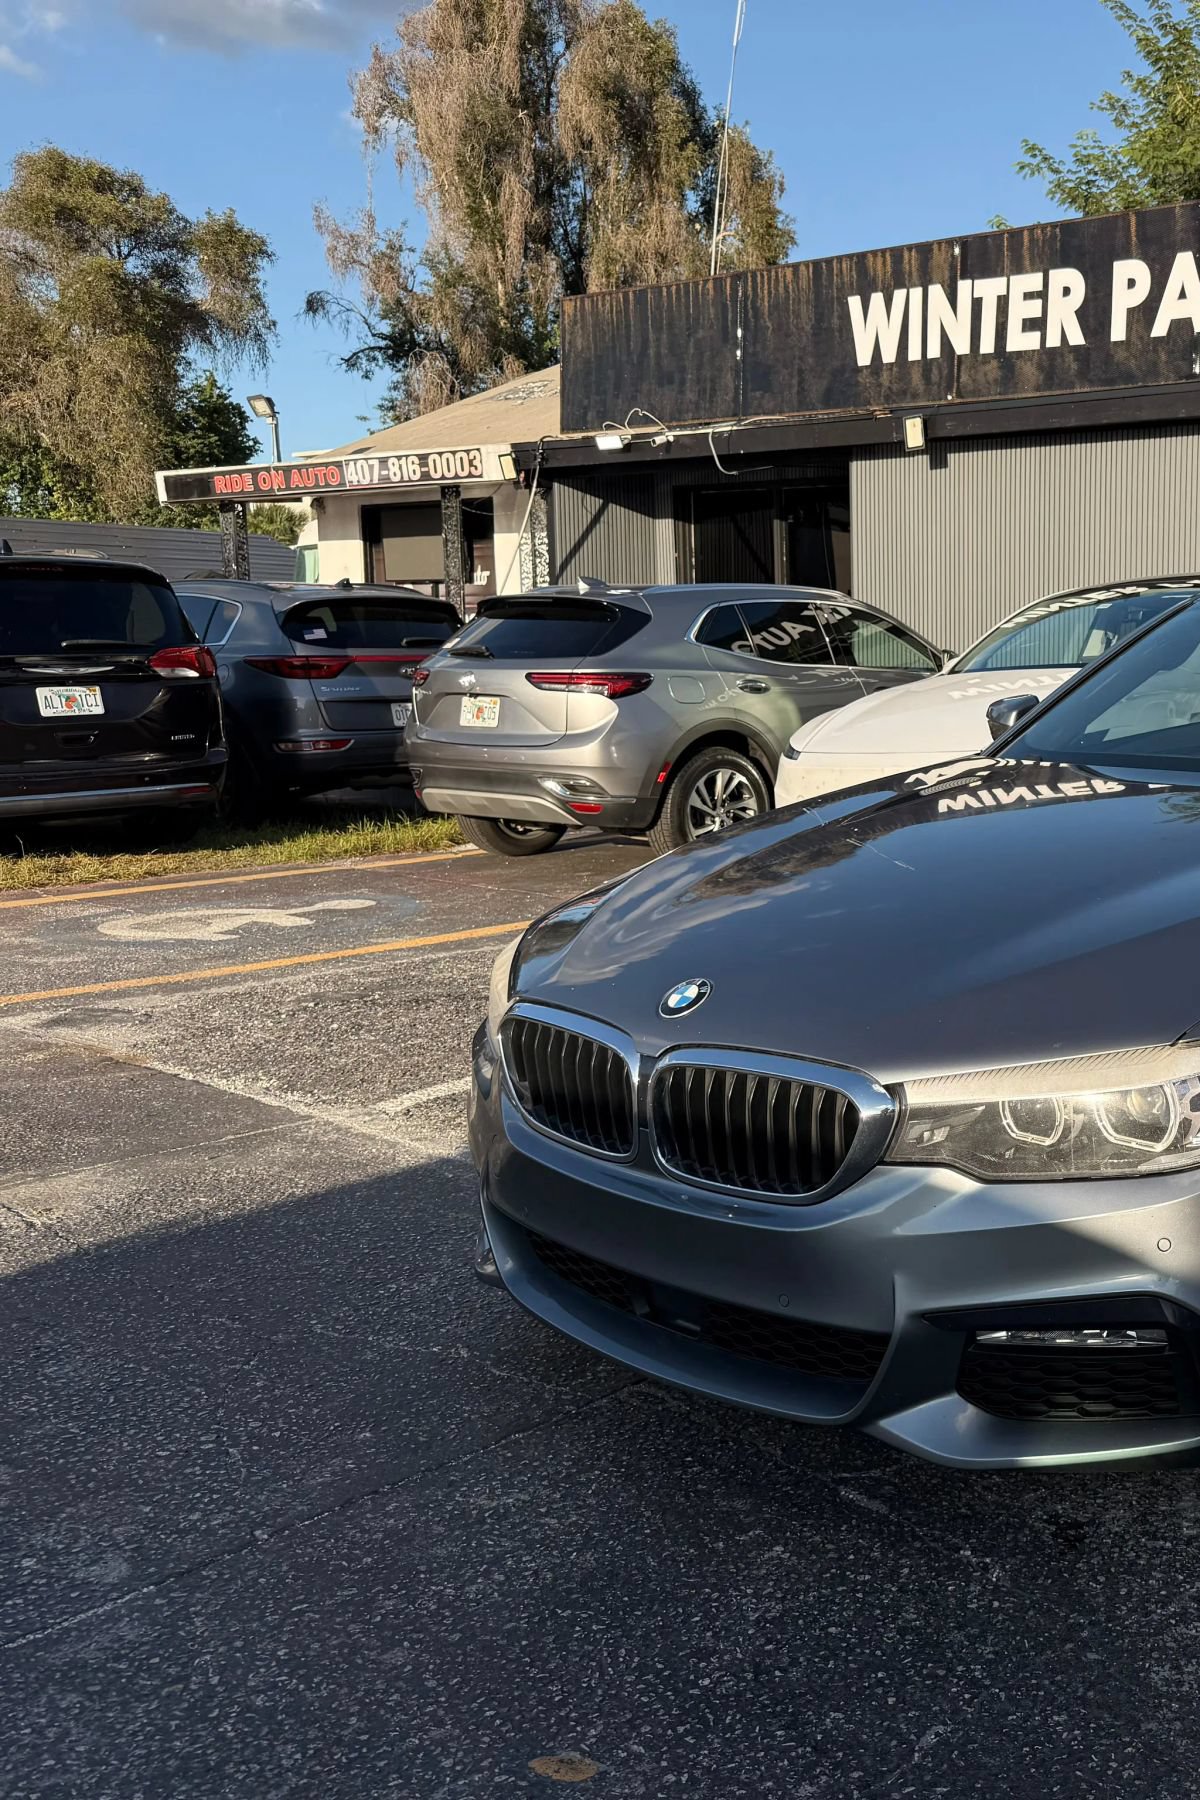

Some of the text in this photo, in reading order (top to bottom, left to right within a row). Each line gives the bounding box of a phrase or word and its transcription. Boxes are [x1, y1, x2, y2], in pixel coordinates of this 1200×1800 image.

[847, 266, 1086, 367] WINTER
[213, 465, 341, 493] RIDE ON AUTO
[347, 449, 483, 486] 407-816-0003
